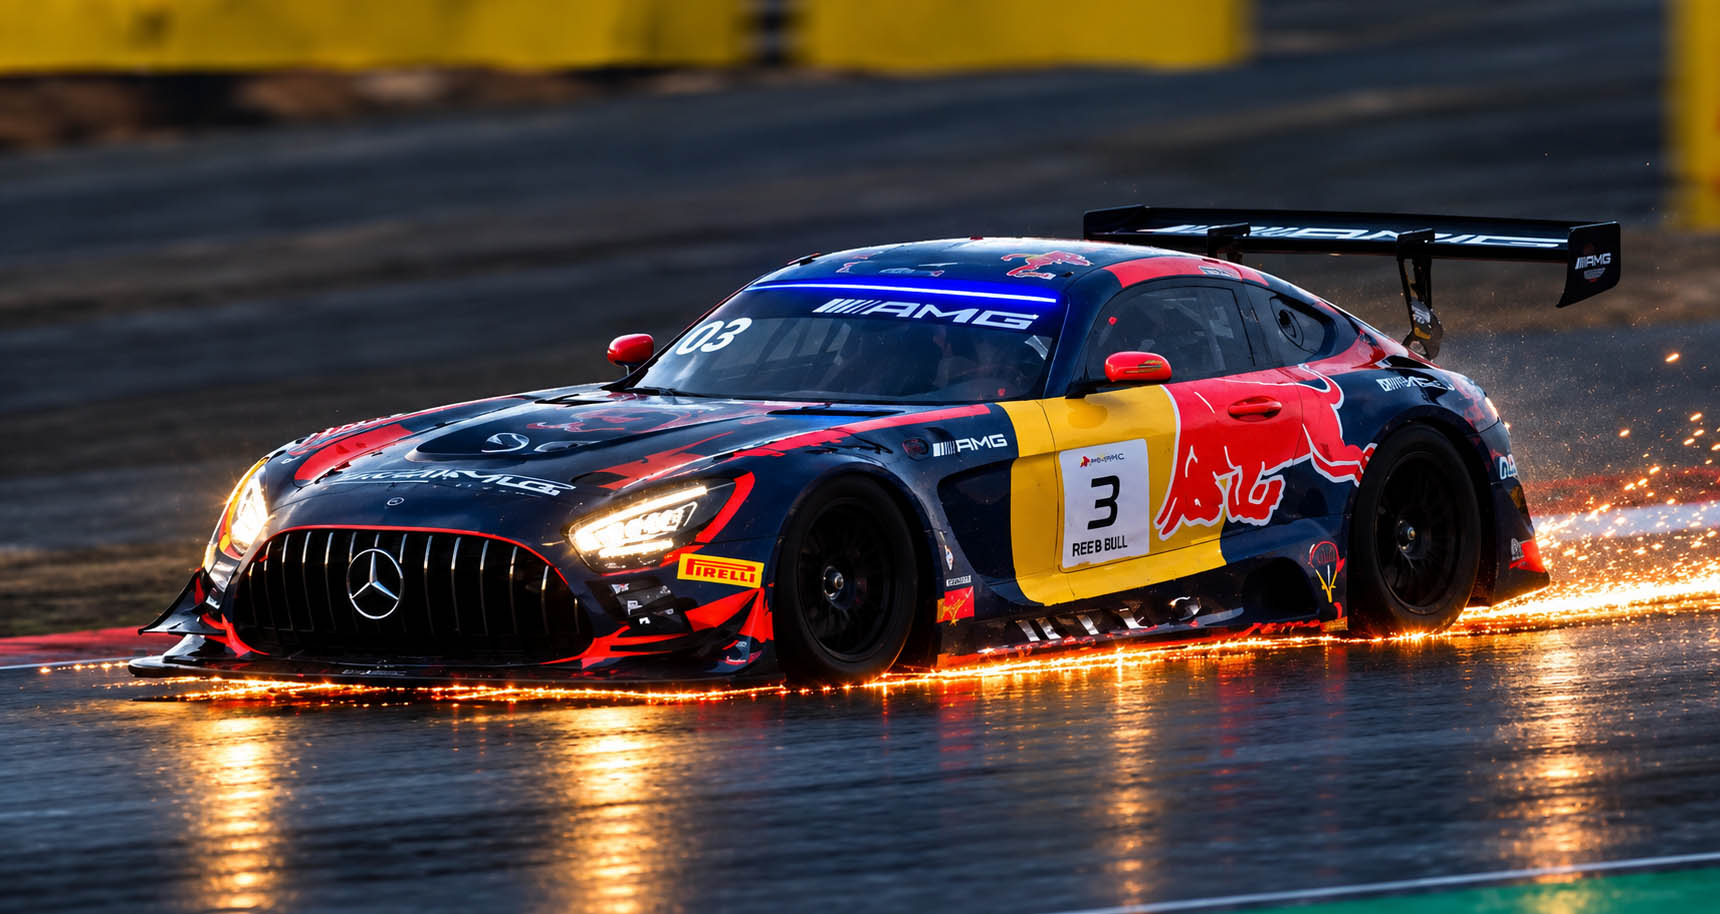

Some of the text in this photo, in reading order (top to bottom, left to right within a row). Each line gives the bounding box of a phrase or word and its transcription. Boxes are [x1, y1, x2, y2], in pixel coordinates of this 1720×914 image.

[1586, 252, 1612, 267] AMG
[862, 301, 1040, 331] AMG
[675, 317, 753, 355] 03
[955, 433, 1009, 453] AMG
[1087, 475, 1121, 530] 3
[1104, 535, 1128, 551] BULL
[685, 558, 757, 584] PIRELLI
